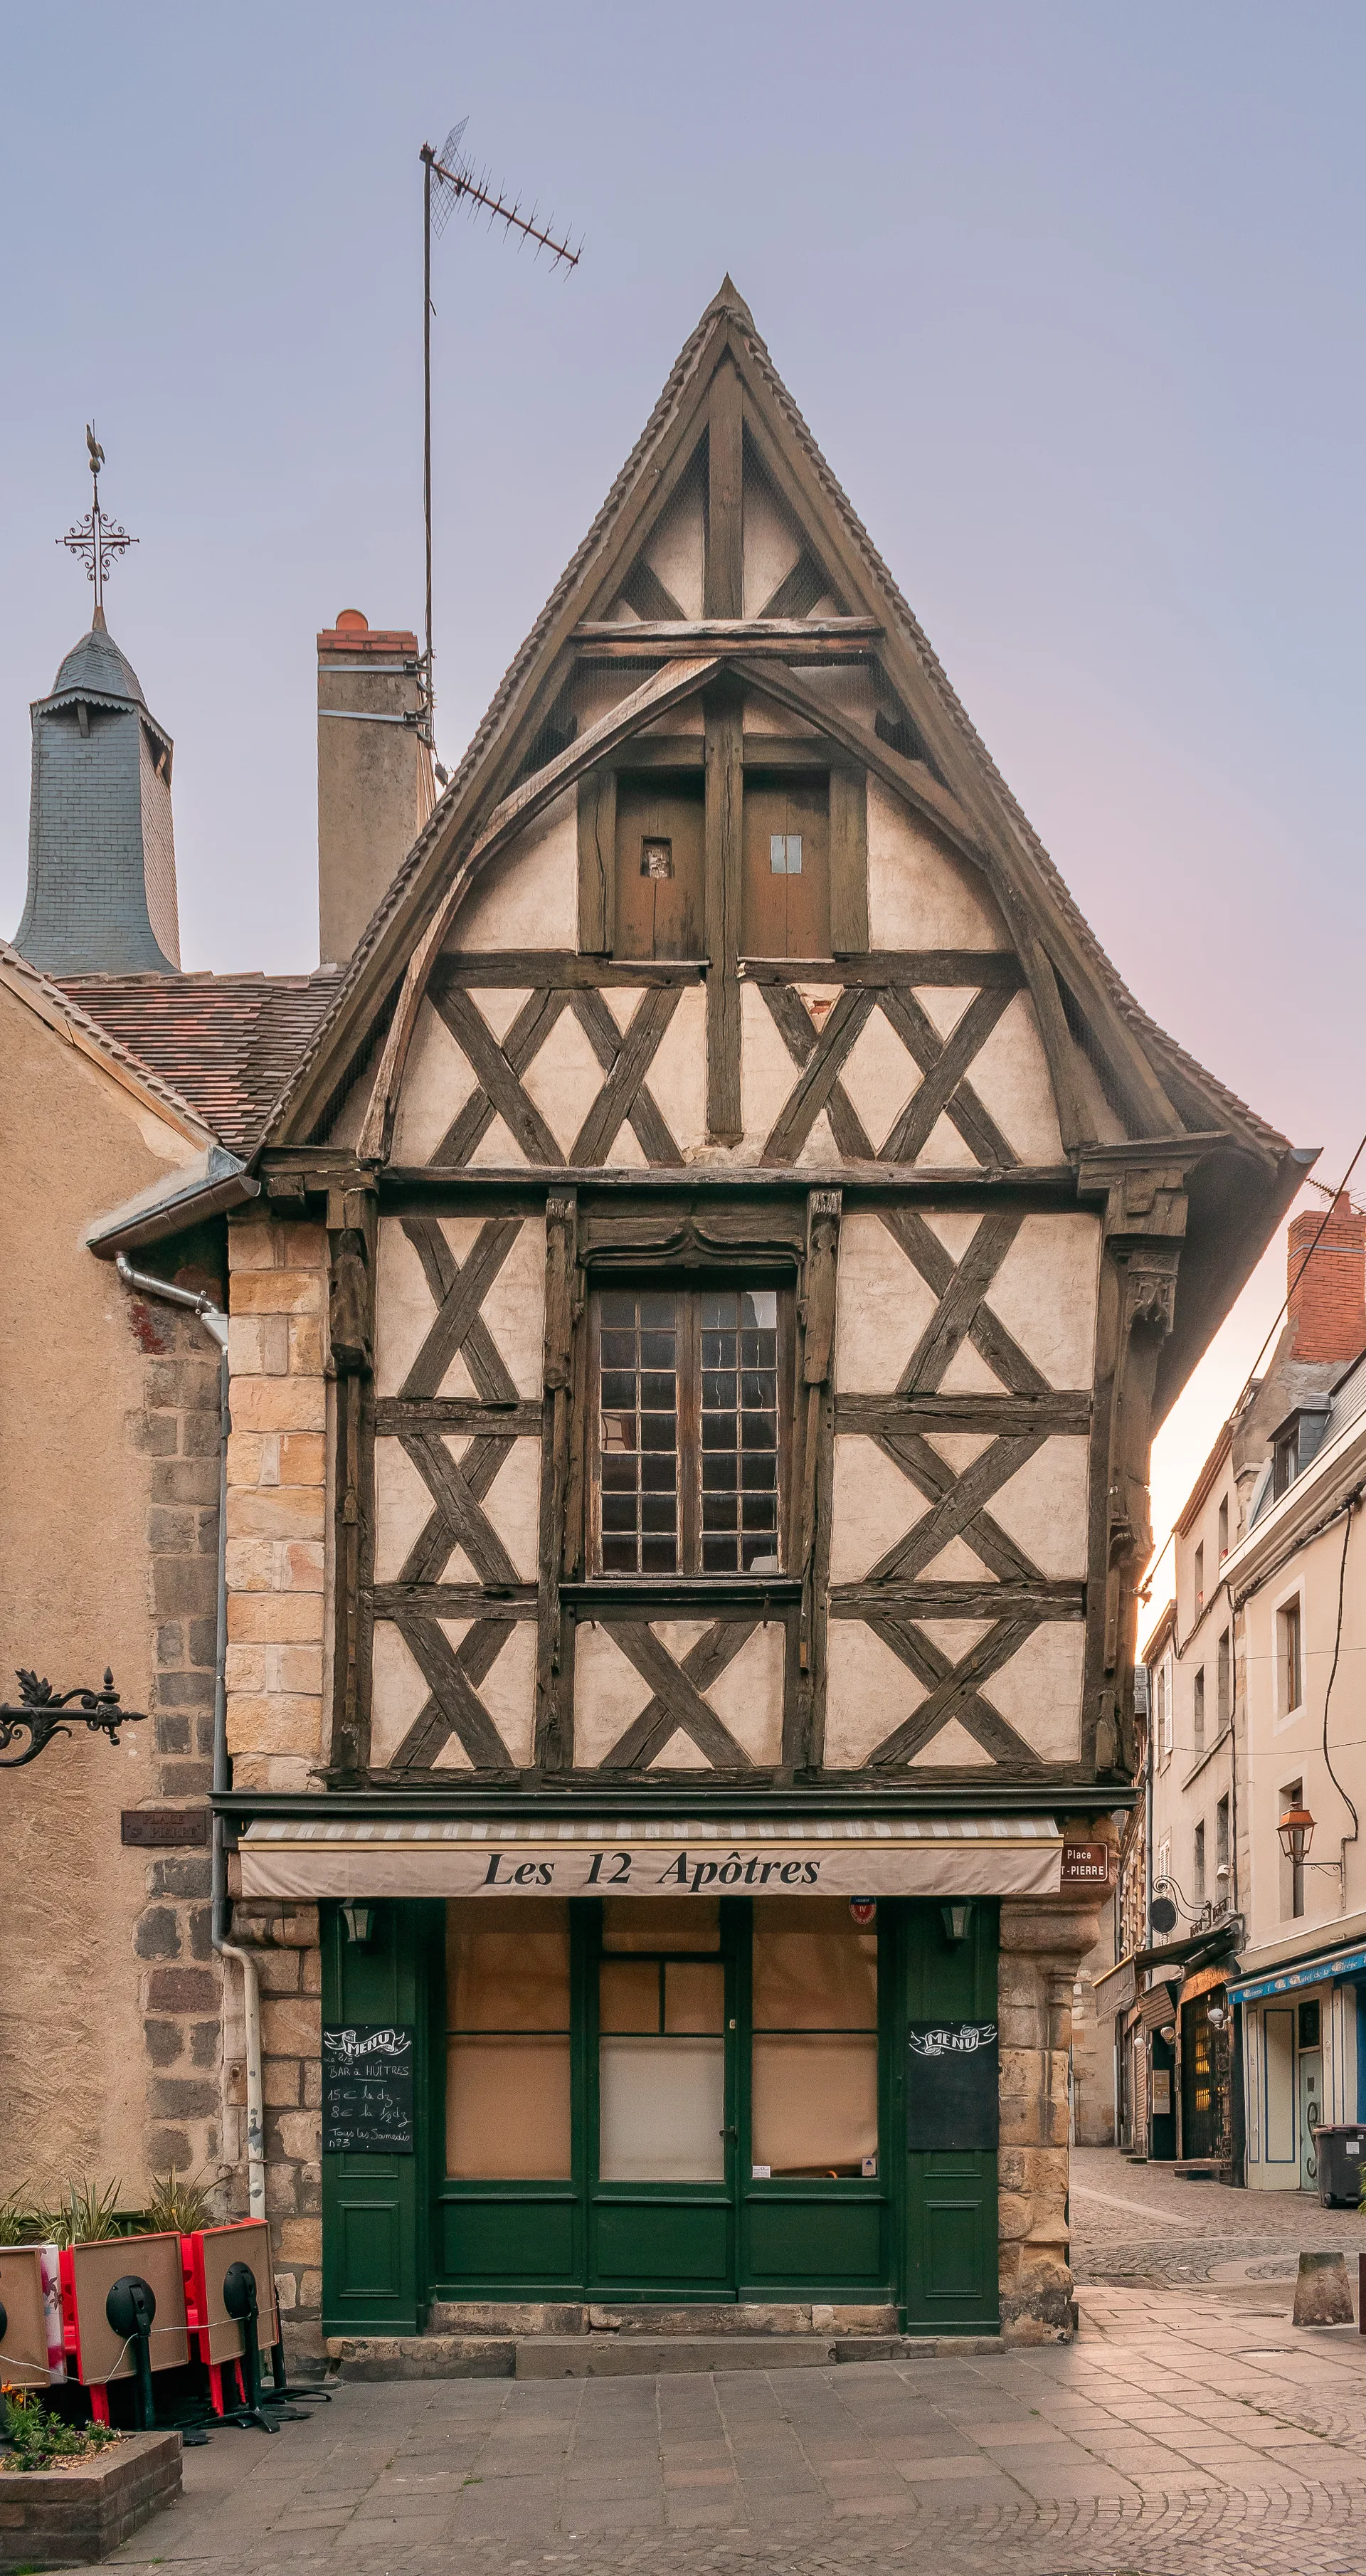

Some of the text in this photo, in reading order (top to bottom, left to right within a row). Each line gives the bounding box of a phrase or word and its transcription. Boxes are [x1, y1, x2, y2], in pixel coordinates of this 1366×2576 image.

[143, 1813, 185, 1824] PLACE
[150, 1827, 198, 1838] PIERRE
[1067, 1850, 1091, 1859] Place
[482, 1852, 821, 1893] Les 12 Apôtres
[347, 2033, 390, 2054] MENU
[927, 2032, 976, 2049] MENU
[328, 2065, 351, 2078] BAR
[331, 2106, 353, 2118] 8€
[329, 2128, 354, 2137] Tous
